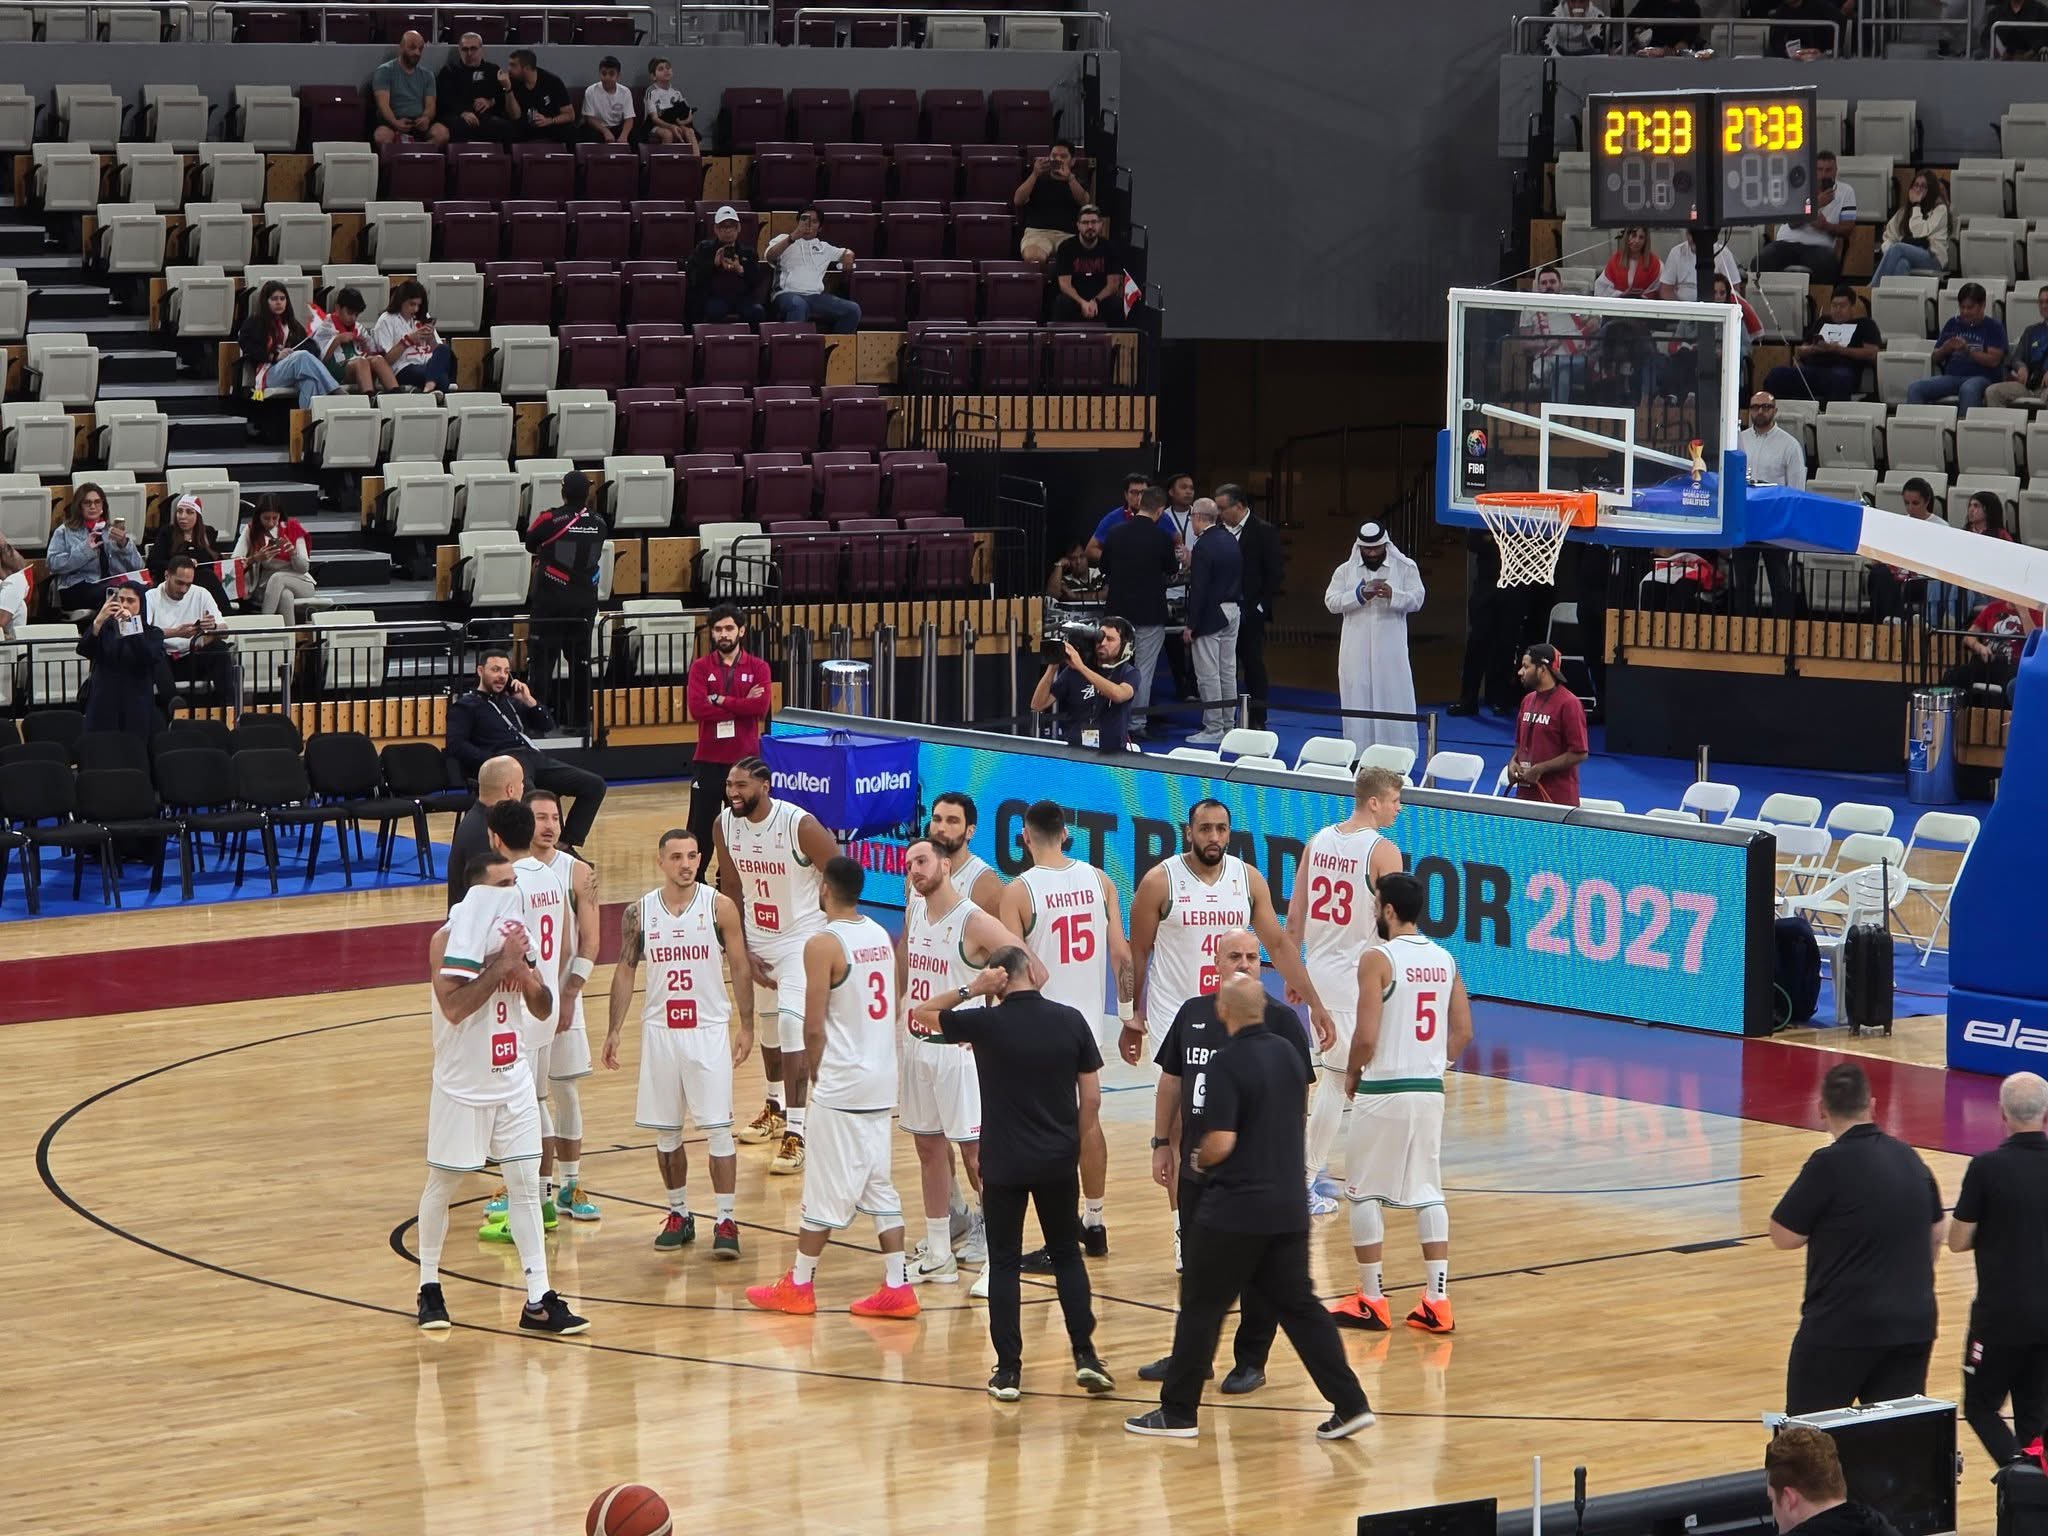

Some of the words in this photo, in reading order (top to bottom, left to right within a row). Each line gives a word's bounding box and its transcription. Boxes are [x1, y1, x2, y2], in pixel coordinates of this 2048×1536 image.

[1605, 110, 1692, 155] 27:33
[1725, 105, 1803, 151] 27:33
[1468, 463, 1485, 474] FIBA
[771, 771, 830, 794] molten
[855, 772, 911, 794] molten
[734, 858, 786, 876] LEBANON
[1313, 852, 1358, 874] KHAYAT
[755, 879, 770, 898] 11
[995, 799, 1118, 878] GT
[1402, 852, 1512, 948] OR
[1526, 872, 1718, 975] 2027
[530, 890, 560, 909] KHALIL
[1045, 889, 1095, 909] KHATIB
[1311, 875, 1353, 926] 23
[757, 911, 776, 923] CFI
[1183, 910, 1244, 926] LEBANON
[540, 914, 554, 961] 8
[1051, 913, 1096, 965] 15
[650, 945, 709, 963] LEBANON
[667, 969, 693, 992] 25
[1203, 974, 1220, 987] CF
[1406, 967, 1447, 983] SAOUD
[868, 971, 888, 1020] 3
[911, 978, 930, 1001] 20
[496, 1001, 508, 1024] 9
[671, 1008, 693, 1020] CFI
[1415, 992, 1437, 1042] 5
[495, 1043, 514, 1058] CFI
